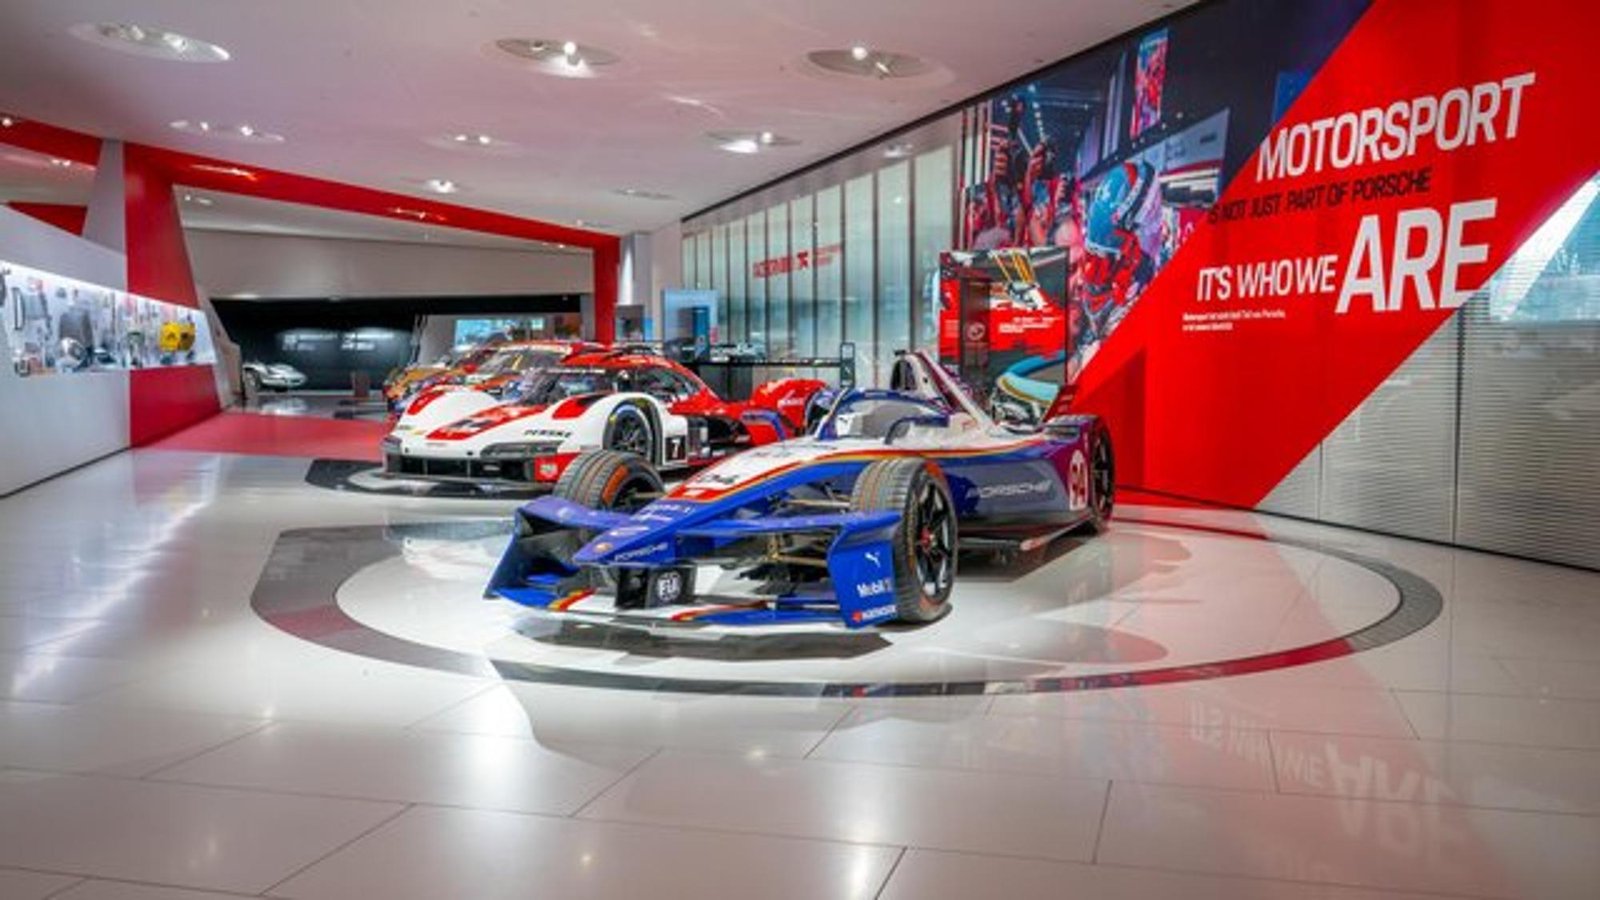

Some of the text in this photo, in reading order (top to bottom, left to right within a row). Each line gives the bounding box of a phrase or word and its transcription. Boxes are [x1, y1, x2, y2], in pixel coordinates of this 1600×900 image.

[1256, 72, 1536, 182] MOTORSPORT
[1249, 194, 1281, 218] JUST
[1287, 184, 1325, 212] PART
[1327, 182, 1348, 207] OF
[1350, 168, 1433, 202] PORSCHE
[1197, 198, 1498, 314] IT'S WHO WE ARE
[966, 480, 1052, 498] PORSCHE
